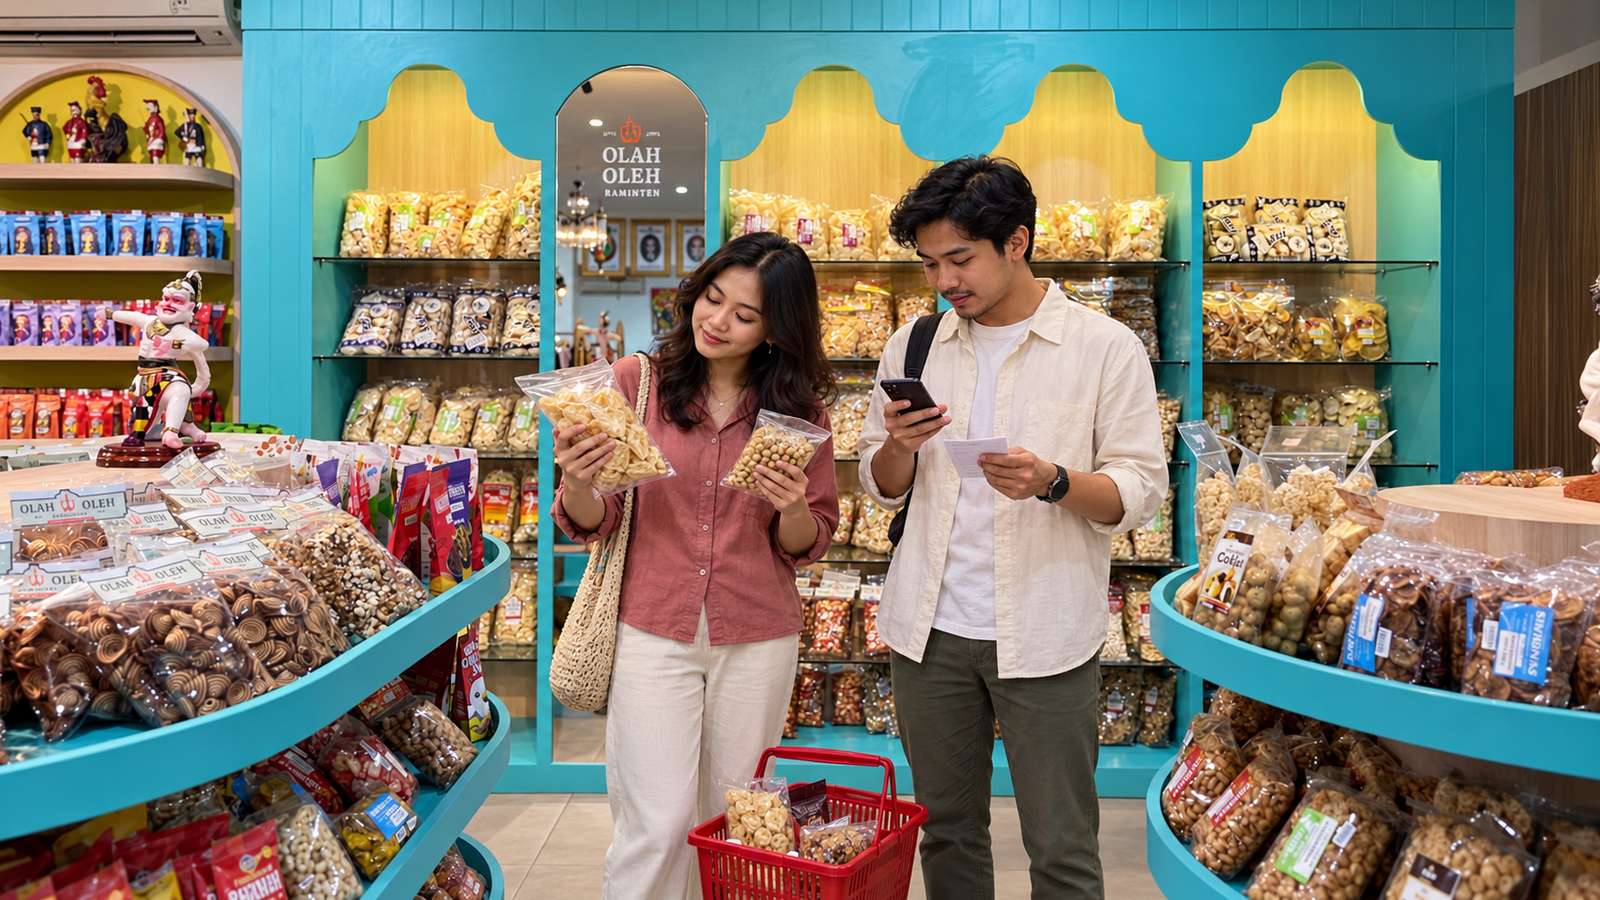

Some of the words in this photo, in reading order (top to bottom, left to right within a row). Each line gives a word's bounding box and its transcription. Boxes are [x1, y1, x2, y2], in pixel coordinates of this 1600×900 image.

[602, 147, 661, 163] OLAH
[602, 168, 661, 184] OLEH
[604, 189, 660, 197] RAMINTEN
[20, 502, 55, 514] OLAH
[82, 497, 115, 510] OLEH
[199, 517, 230, 526] OLAH
[99, 579, 134, 591] OLAH
[155, 566, 187, 579] OLEH
